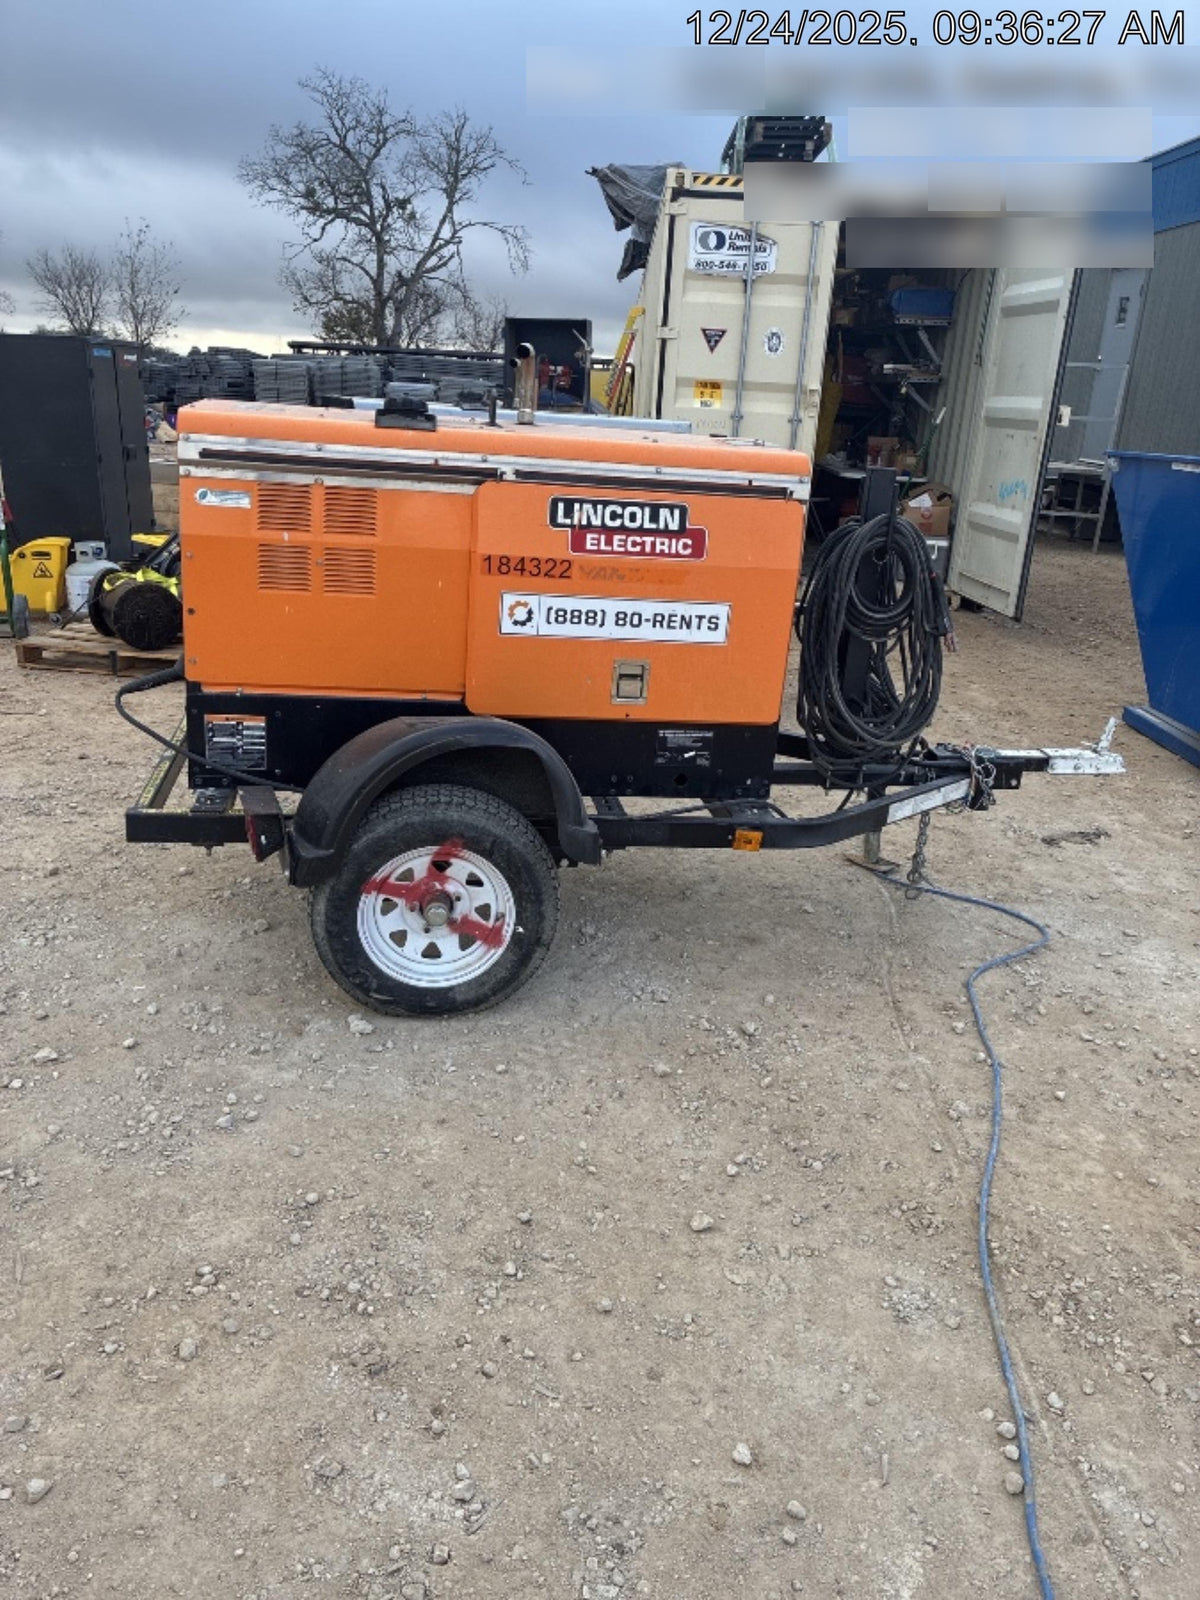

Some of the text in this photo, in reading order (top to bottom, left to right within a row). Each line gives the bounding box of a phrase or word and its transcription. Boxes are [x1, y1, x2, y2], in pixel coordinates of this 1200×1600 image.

[557, 501, 680, 531] LINCOLN
[585, 533, 693, 555] ELECTRIC
[483, 555, 573, 579] 184322
[614, 610, 720, 632] 80-RENTS
